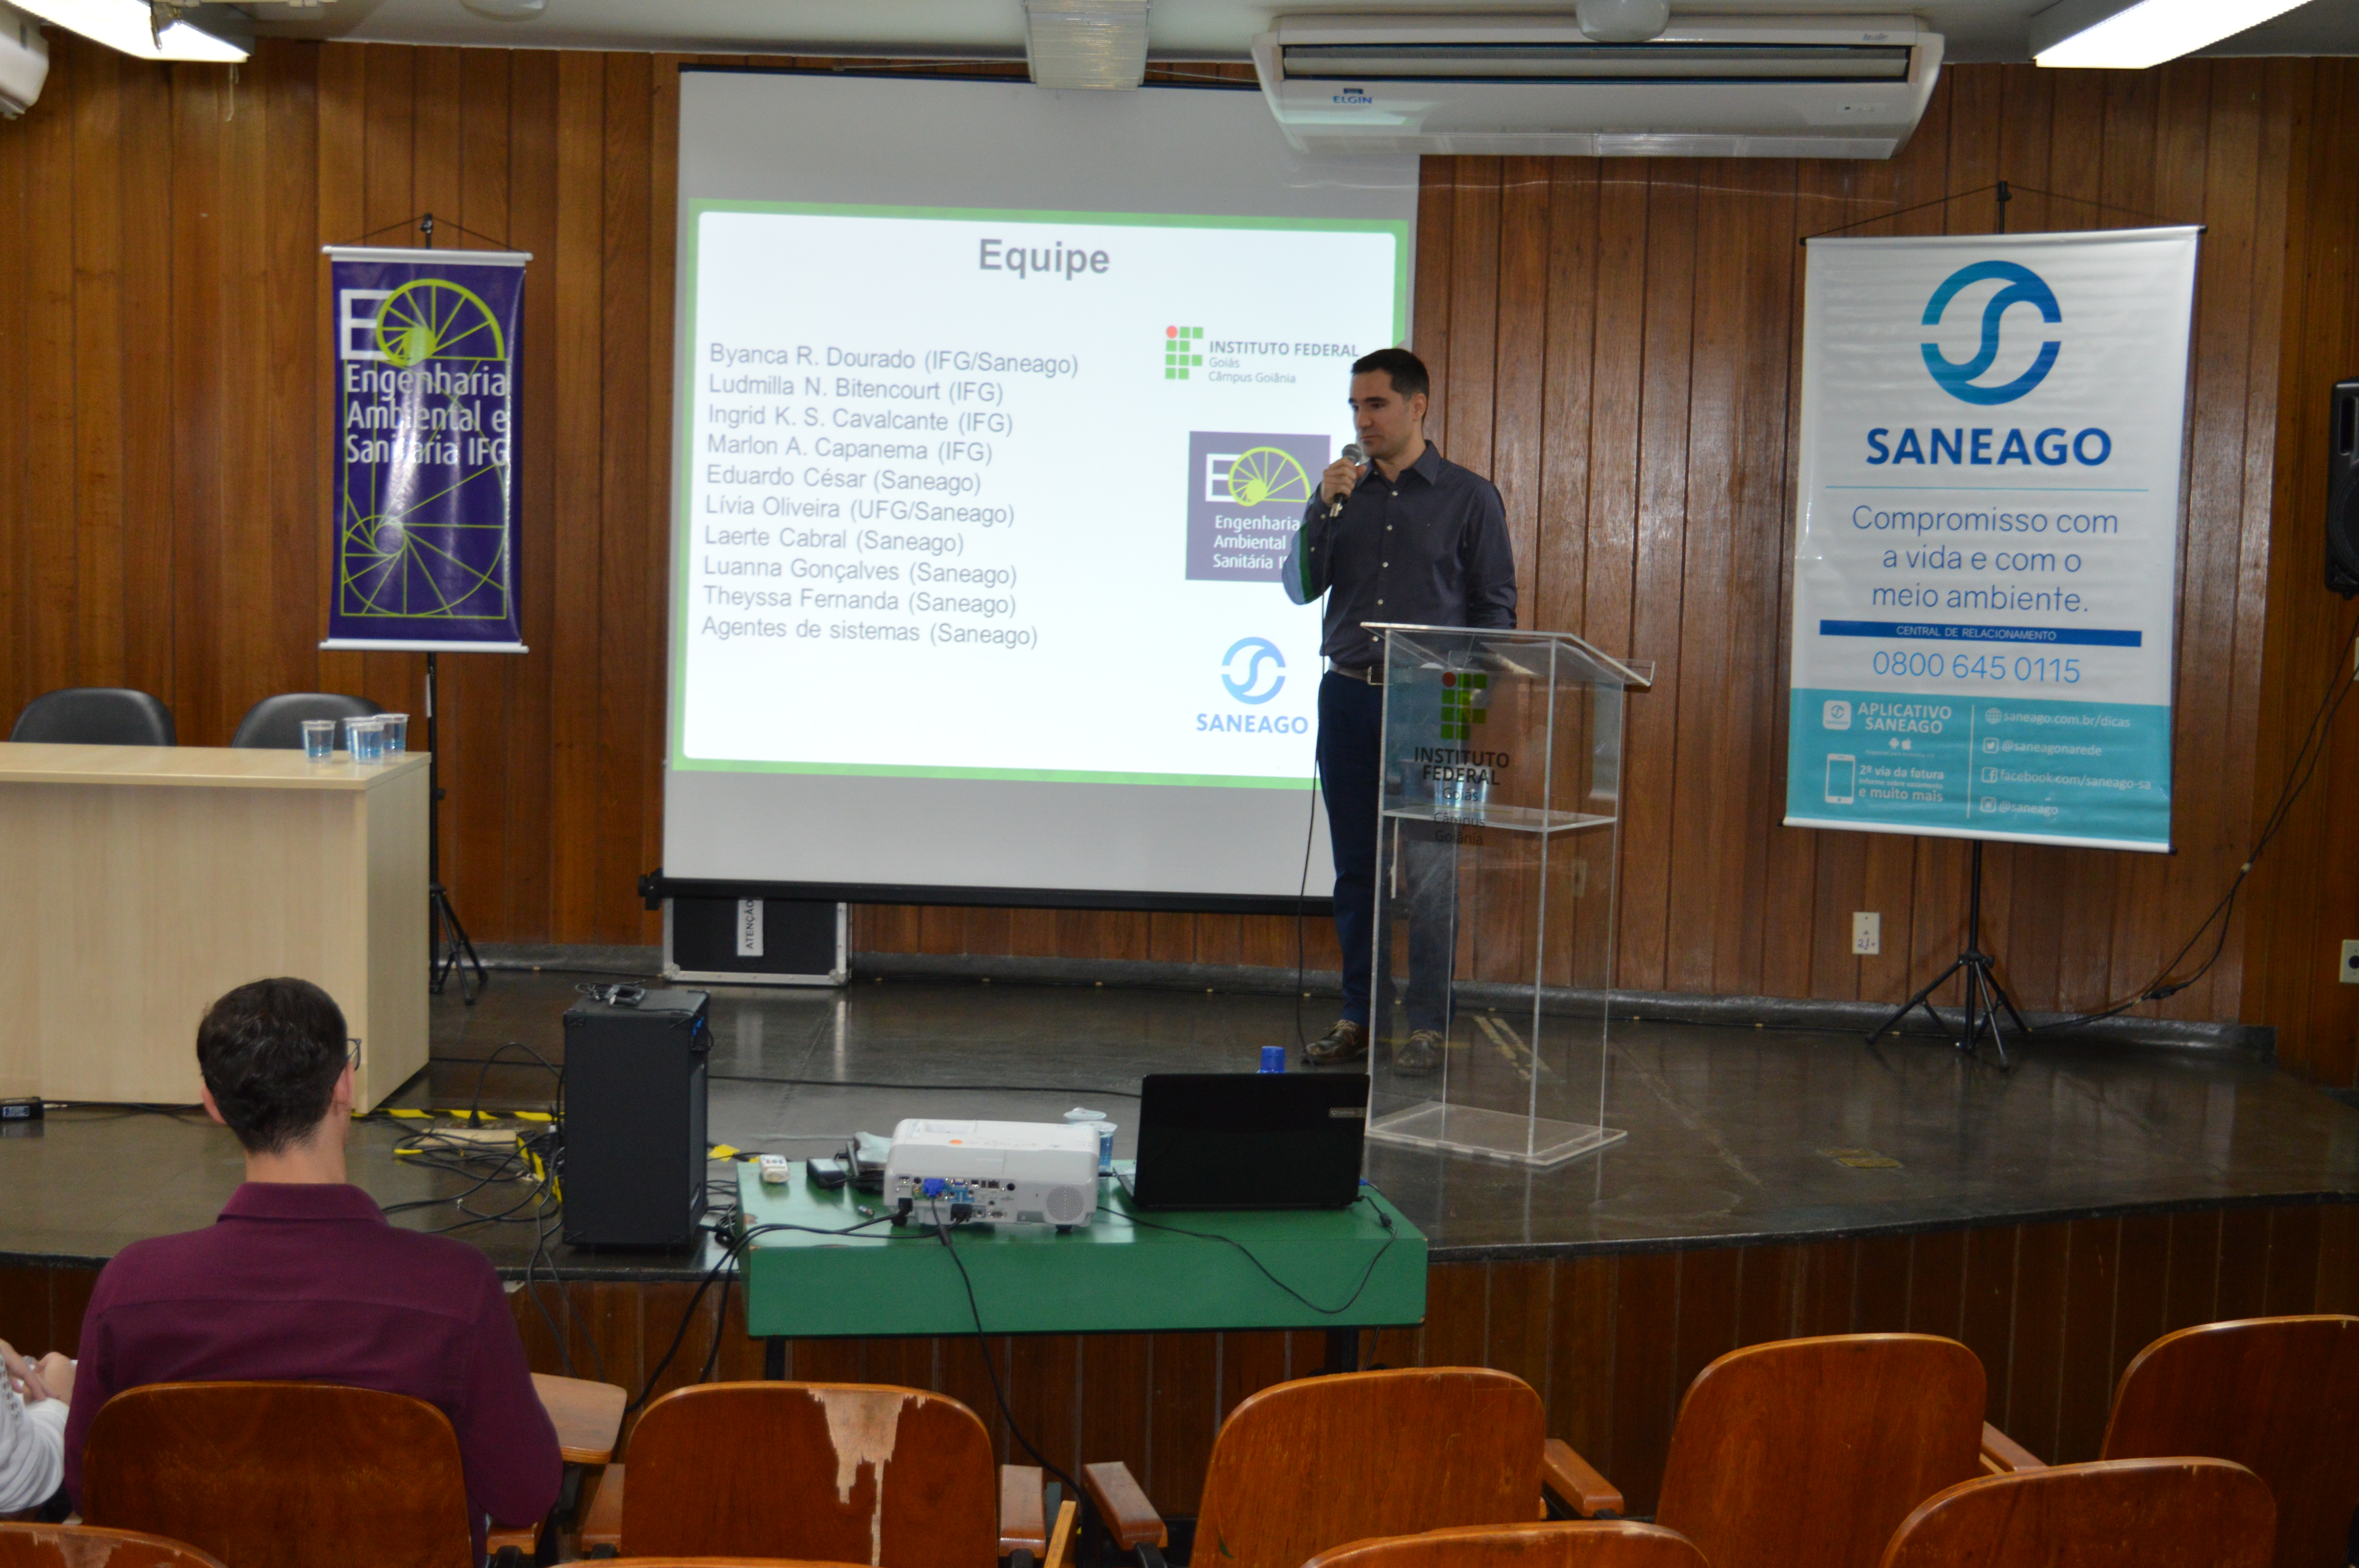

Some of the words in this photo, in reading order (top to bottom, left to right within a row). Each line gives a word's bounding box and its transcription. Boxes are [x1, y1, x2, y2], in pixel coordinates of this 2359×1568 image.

[979, 239, 1110, 280] Equipe
[1210, 341, 1289, 356] INSTITUTO
[1294, 343, 1359, 357] FEDERAL
[710, 343, 788, 369] Byanca
[797, 346, 818, 366] R.
[827, 347, 916, 368] Dourado
[925, 350, 1078, 378] (IFG/Saneago)
[1209, 357, 1240, 368] Goiás
[347, 363, 507, 401] Engenharia
[1209, 371, 1252, 384] Câmpus
[1256, 372, 1296, 383] Goiânia
[710, 374, 794, 396] Ludmilla
[805, 377, 827, 397] N.
[836, 378, 941, 400] Bitencourt
[949, 381, 1003, 407] (IFG)
[493, 410, 507, 432] e
[709, 405, 765, 430] Ingrid
[775, 407, 796, 426] K.
[804, 408, 824, 427] S.
[833, 408, 948, 431] Cavalcante
[958, 412, 1013, 437] (IFG)
[347, 434, 458, 465] Sanária
[469, 437, 507, 466] IFG
[707, 435, 778, 456] Marlon
[786, 437, 807, 456] A.
[815, 437, 928, 462] Capanema
[938, 441, 992, 466] (IFG)
[1866, 427, 2112, 466] SANEAGO
[706, 465, 794, 486] Eduardo
[804, 466, 866, 488] César
[873, 469, 981, 496] (Saneago)
[706, 495, 754, 515] Lívia
[763, 496, 840, 517] Oliveira
[851, 499, 1014, 527] (UFG/Saneago)
[1853, 505, 2048, 536] Compromisso
[2057, 512, 2117, 534] com
[1215, 515, 1301, 533] Engenharia
[705, 526, 770, 546] Laerte
[780, 528, 846, 549] Cabral
[856, 530, 964, 557] (Saneago)
[1214, 534, 1287, 550] Ambiental
[1213, 554, 1274, 569] Sanitária
[1883, 549, 1897, 567] a
[1907, 545, 1962, 570] vida
[1971, 552, 1986, 570] e
[1996, 553, 2055, 572] com
[2065, 555, 2081, 572] o
[704, 556, 782, 577] Luanna
[791, 558, 900, 584] Gonçalves
[909, 562, 1017, 588] (Saneago)
[703, 586, 792, 612] Theyssa
[800, 588, 899, 611] Fernanda
[909, 592, 1016, 618] (Saneago)
[1872, 584, 1938, 608] meio
[1947, 585, 2088, 612] ambiente.
[702, 617, 787, 640] Agentes
[796, 620, 821, 638] de
[830, 621, 920, 642] sistemas
[930, 622, 1038, 650] (Saneago)
[1896, 626, 1940, 637] CENTRAL
[1945, 628, 1958, 637] DE
[1962, 628, 2056, 641] RELACIONAMENTO
[1873, 651, 1944, 677] 0800
[1953, 654, 2005, 680] 645
[2014, 657, 2080, 683] 0115
[1858, 702, 1952, 719] APLICATIVO
[2003, 711, 2131, 728] saneago.com.br/dicas
[1196, 713, 1309, 734] SANEAGO
[1865, 717, 1943, 734] SANEAGO
[1415, 747, 1509, 768] INSTITUTO
[2002, 740, 2102, 756] @saneagonarede
[1423, 765, 1500, 785] FEDERAL
[1875, 766, 1891, 777] via
[1894, 767, 1907, 777] da
[1910, 768, 1944, 780] fatura
[2000, 769, 2151, 791] facebook.com/saneago-sa
[1443, 787, 1478, 801] Goiás
[1859, 788, 1866, 797] e
[1870, 788, 1908, 800] muito
[1912, 789, 1943, 802] mais
[1999, 801, 2058, 817] @saneago
[1434, 812, 1485, 830] Câmpus
[745, 900, 755, 949] ATENÇÃO
